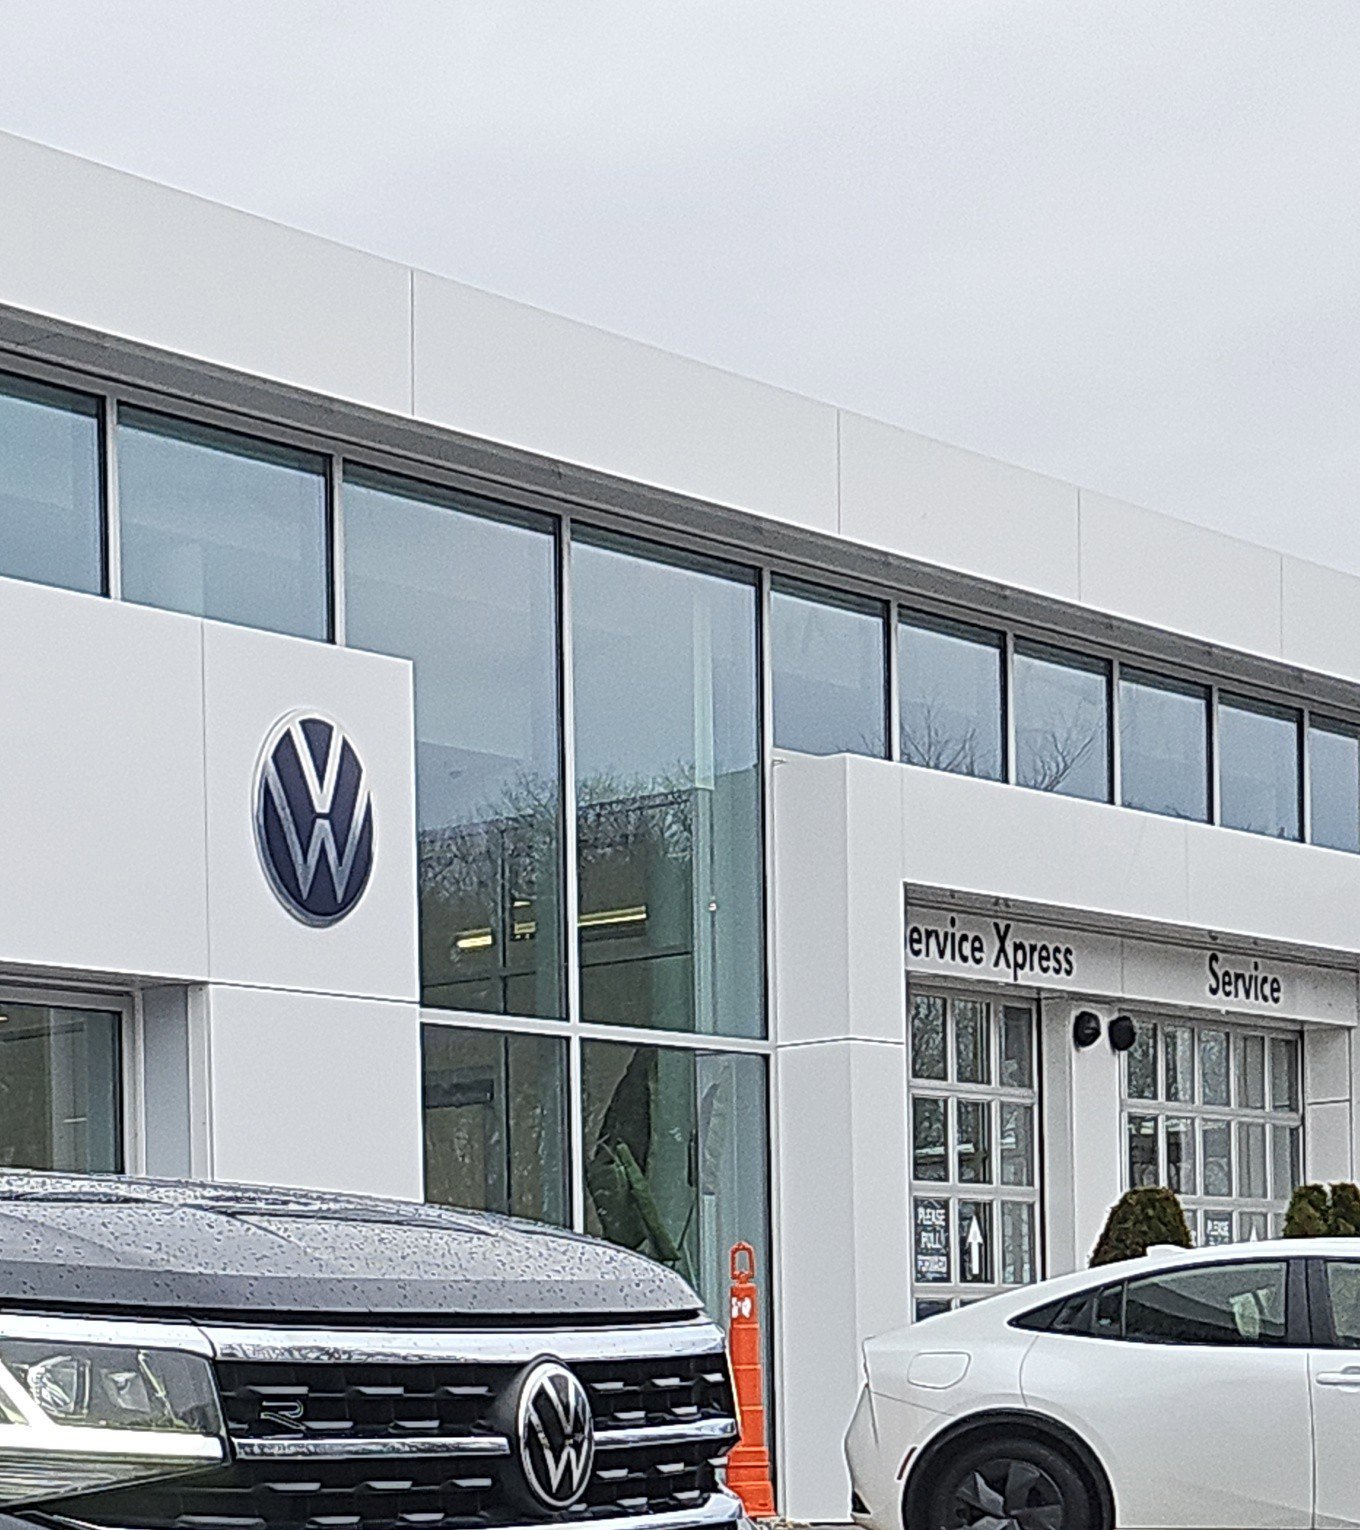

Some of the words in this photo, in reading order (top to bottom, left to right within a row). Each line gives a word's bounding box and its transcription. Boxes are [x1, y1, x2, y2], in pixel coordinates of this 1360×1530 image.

[908, 915, 985, 966] ervice
[992, 921, 1074, 983] Xpress
[1208, 952, 1282, 1005] Service
